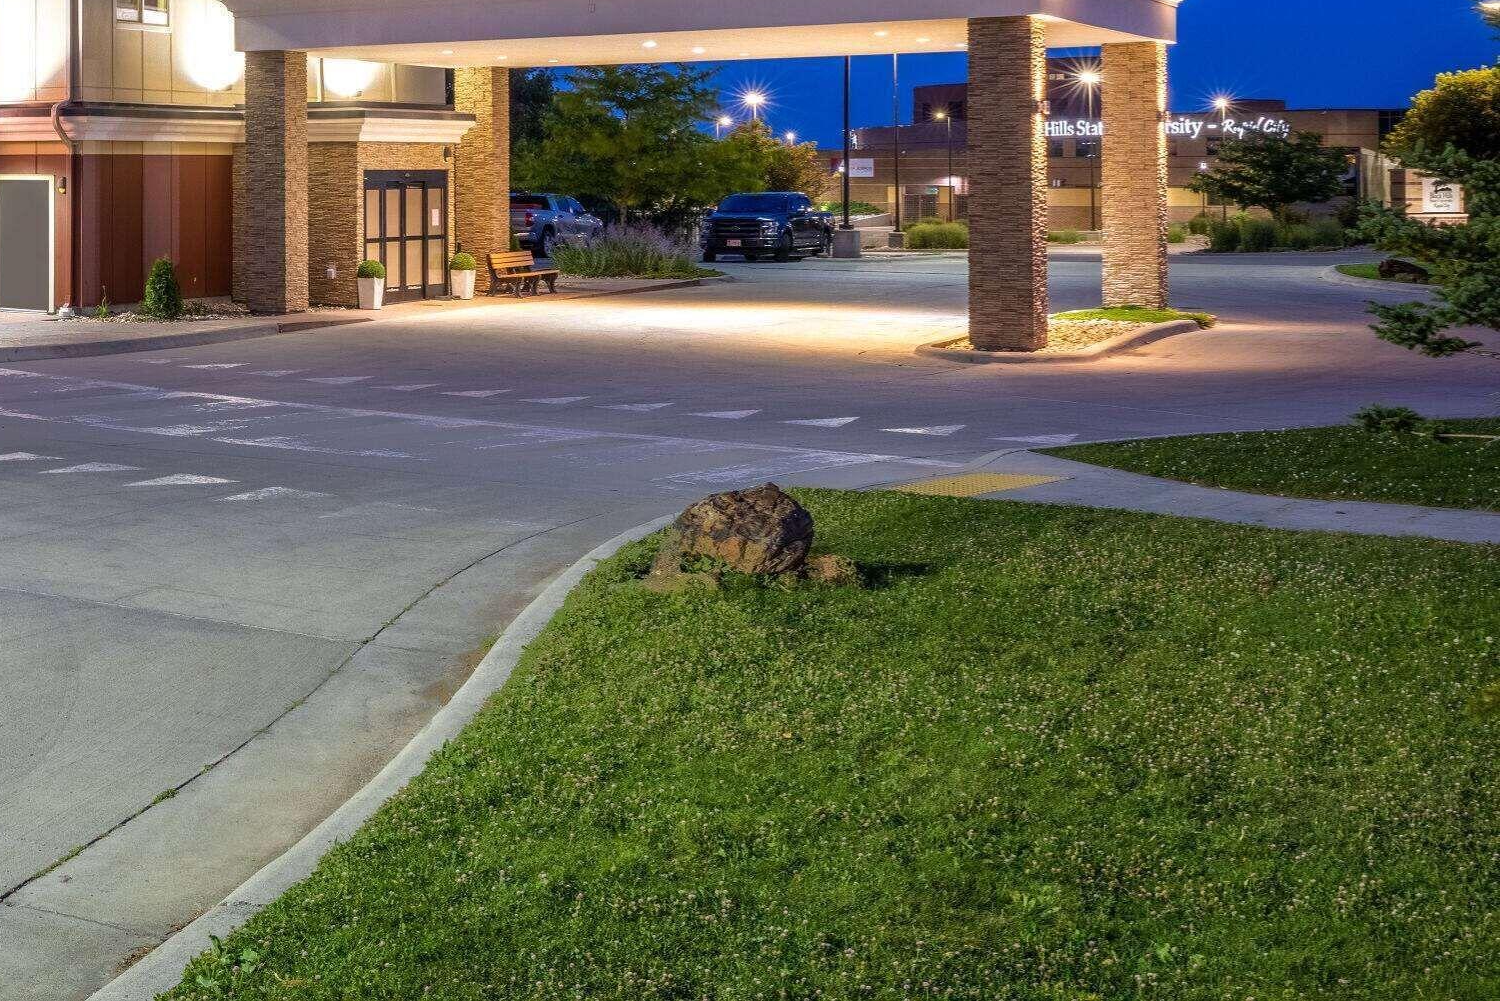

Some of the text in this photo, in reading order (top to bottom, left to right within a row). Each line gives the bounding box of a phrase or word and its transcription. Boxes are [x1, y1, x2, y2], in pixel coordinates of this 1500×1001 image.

[1044, 120, 1075, 137] Hills
[1076, 120, 1104, 136] Stat
[1164, 117, 1204, 139] rsity
[1263, 118, 1290, 139] City
